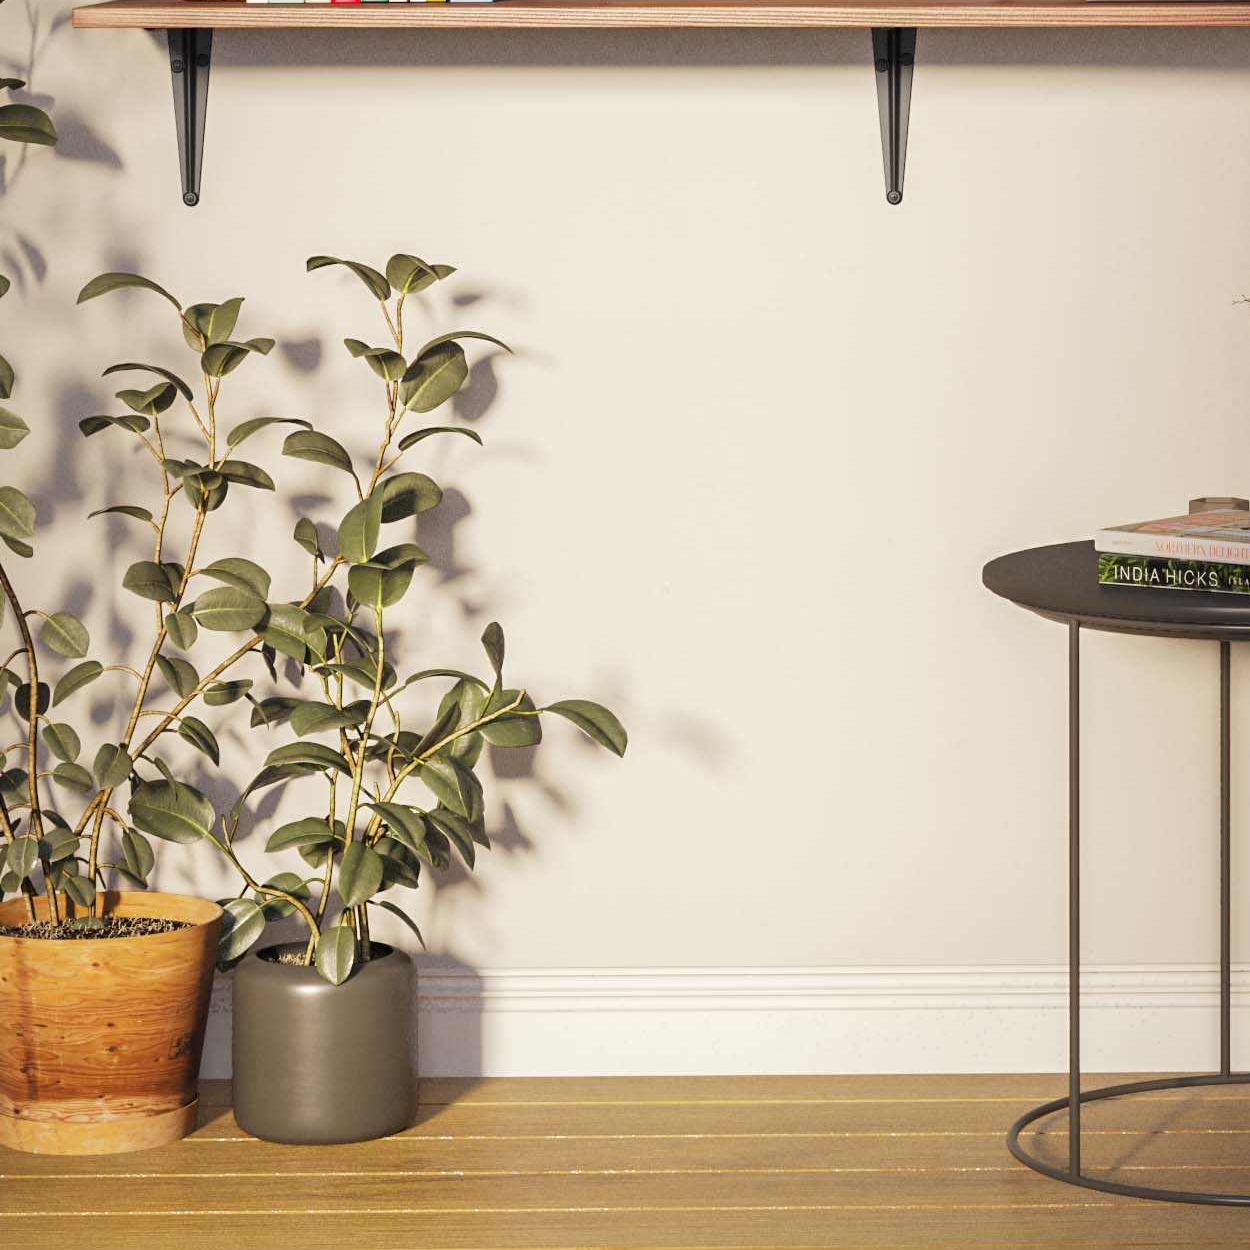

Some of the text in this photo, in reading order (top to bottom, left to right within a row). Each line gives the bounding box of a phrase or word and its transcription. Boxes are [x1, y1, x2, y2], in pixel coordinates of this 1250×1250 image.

[1153, 540, 1204, 555] NORTHERN
[1113, 564, 1219, 587] INDIA HICKS
